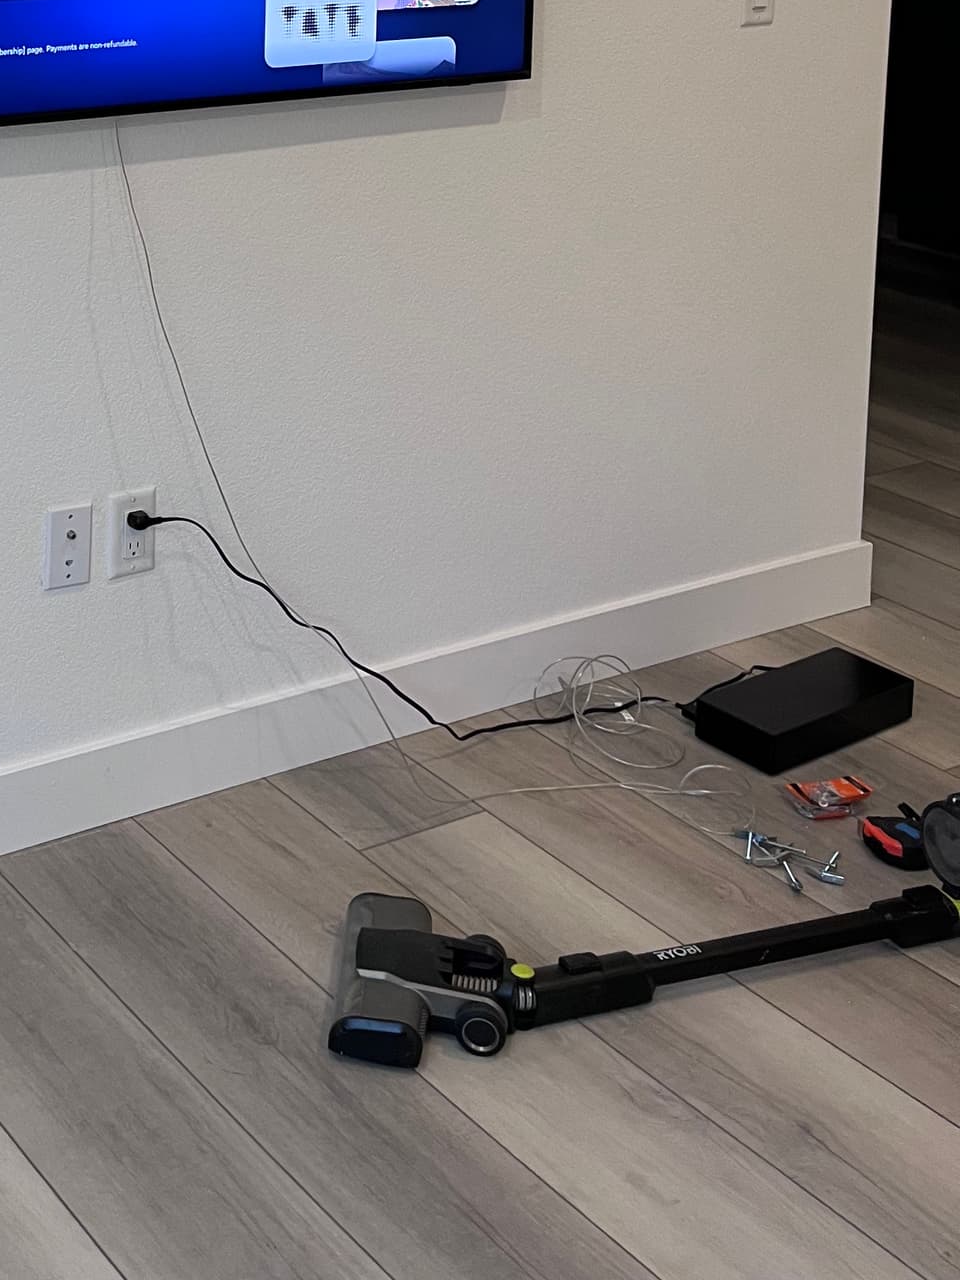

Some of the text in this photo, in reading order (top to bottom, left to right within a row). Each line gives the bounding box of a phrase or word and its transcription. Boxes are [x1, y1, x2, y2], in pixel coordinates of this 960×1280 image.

[46, 43, 77, 53] Payments
[79, 42, 89, 50] are
[653, 945, 702, 960] RYOBI
